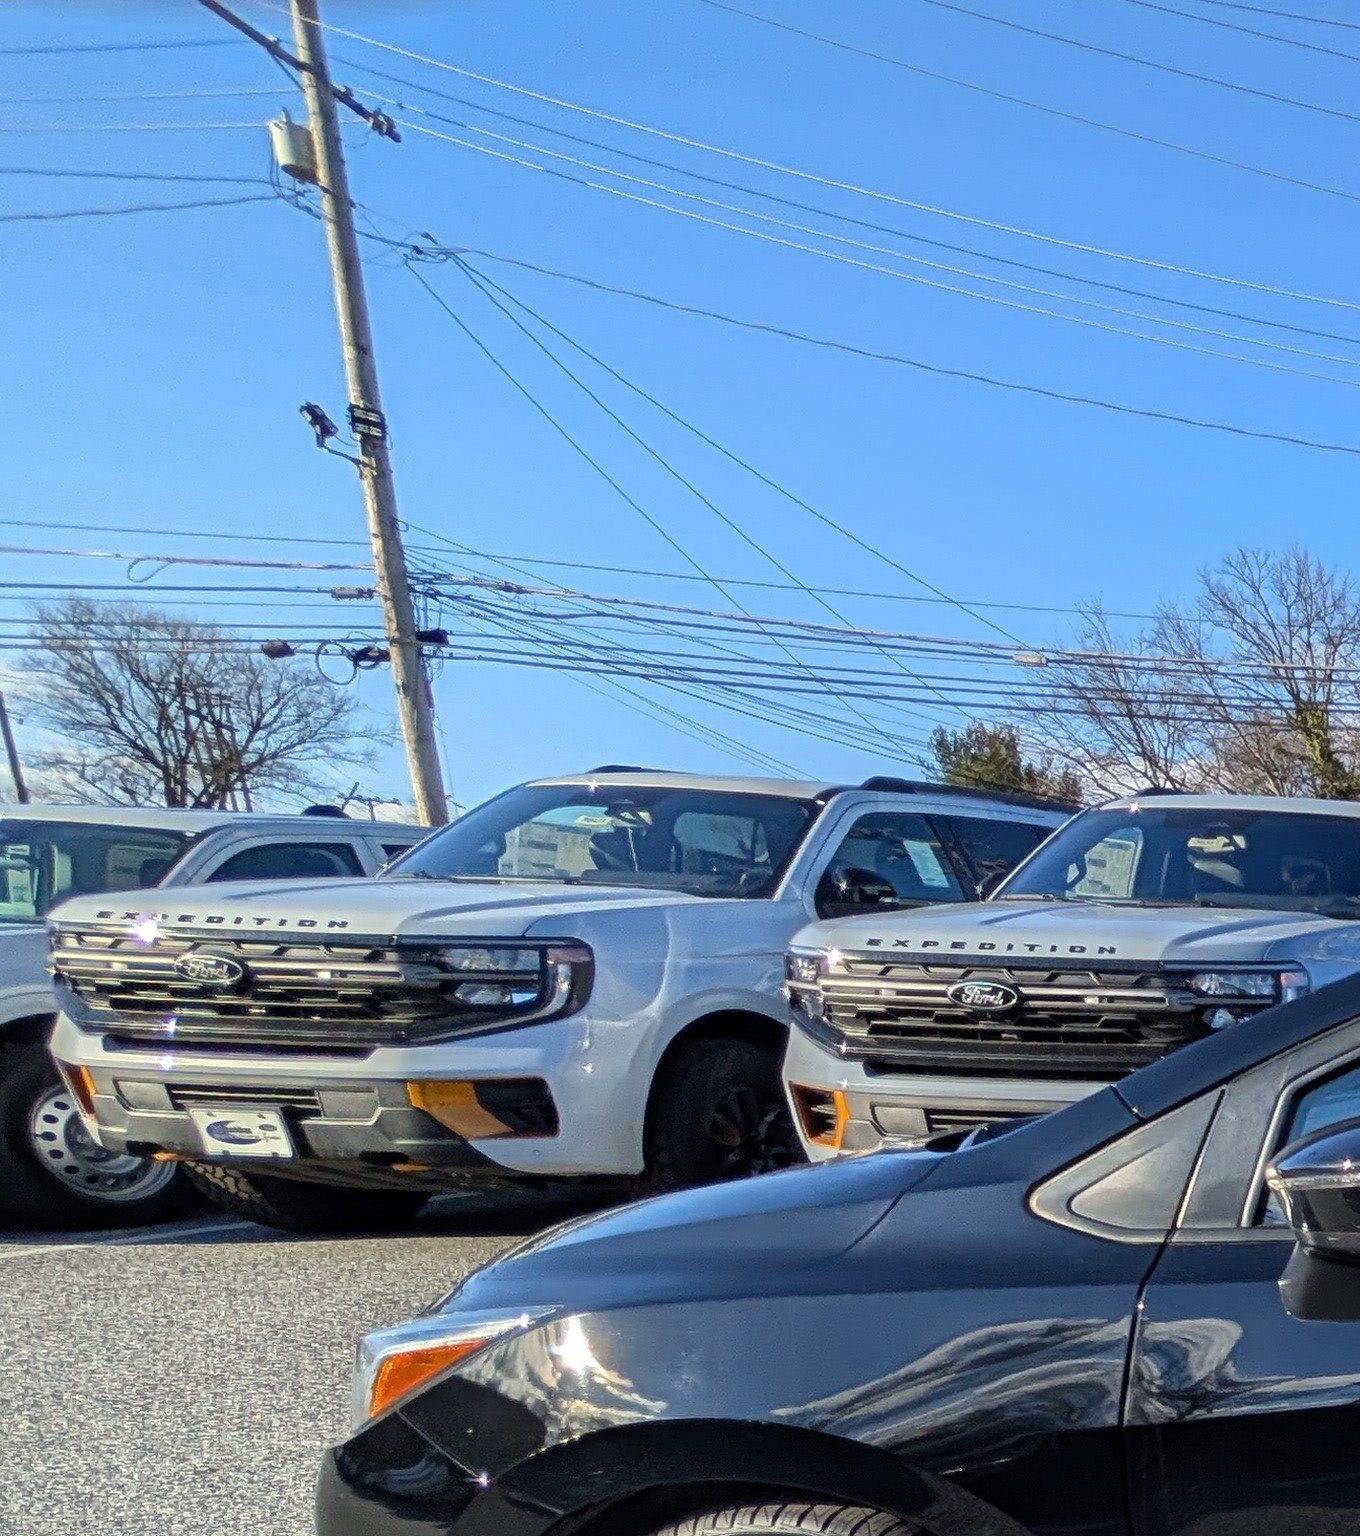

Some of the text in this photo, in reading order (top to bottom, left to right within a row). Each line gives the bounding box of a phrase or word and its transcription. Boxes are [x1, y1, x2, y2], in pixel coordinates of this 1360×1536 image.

[866, 938, 1117, 955] EXPEDITION
[178, 955, 234, 980] Ford
[957, 981, 1009, 1007] Ford
